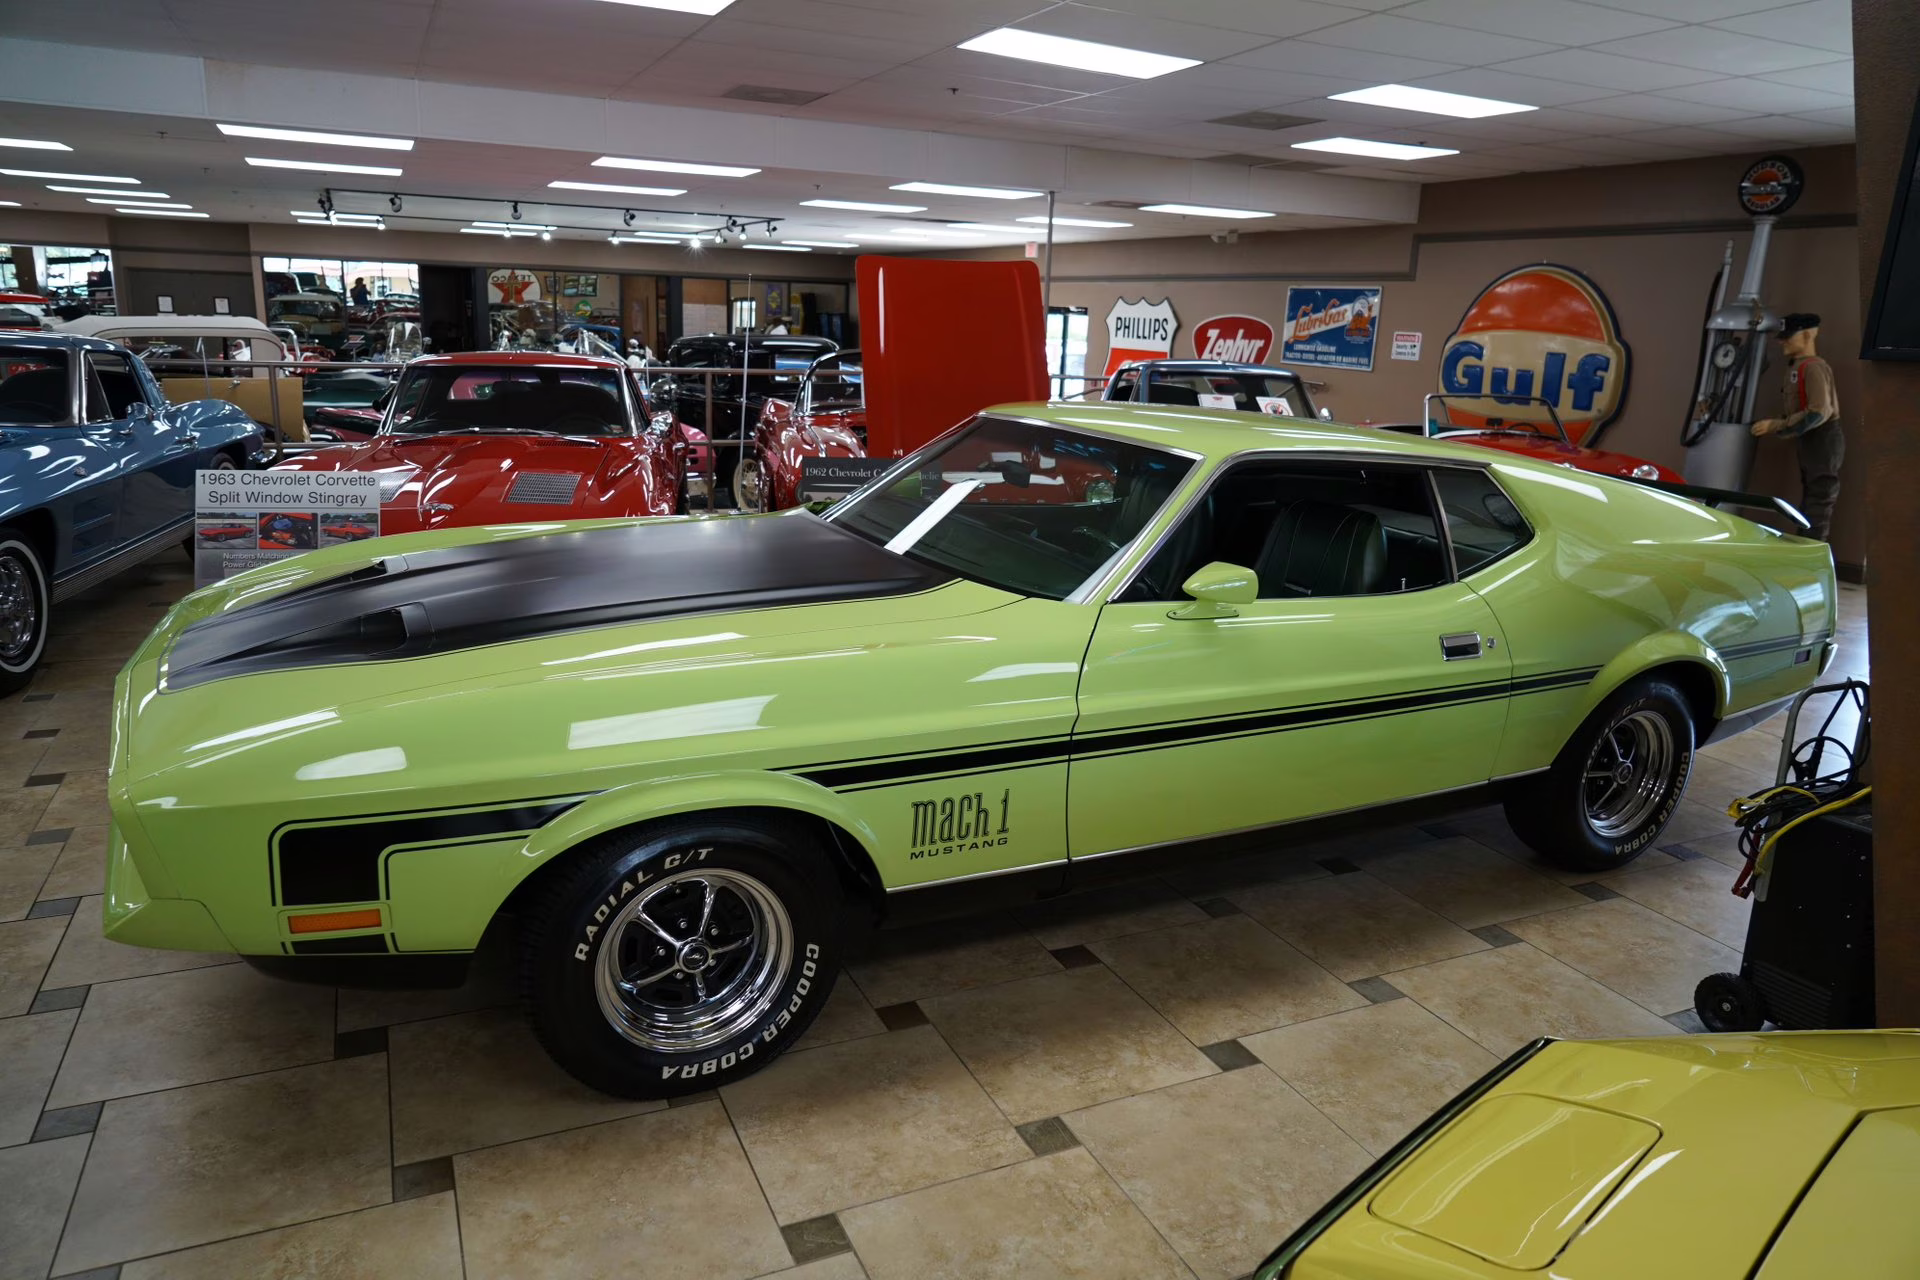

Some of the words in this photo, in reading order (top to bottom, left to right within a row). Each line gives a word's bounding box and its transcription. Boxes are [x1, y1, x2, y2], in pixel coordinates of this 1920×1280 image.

[1115, 316, 1169, 341] PHILLIPS
[1201, 328, 1265, 365] Zephyr
[1442, 340, 1611, 411] Gulf
[200, 473, 236, 485] 1963
[241, 473, 310, 486] Chevrolet
[316, 474, 376, 487] Corvette
[805, 467, 827, 477] 1962
[829, 467, 871, 478] Chevrolet
[208, 490, 241, 505] Split
[245, 491, 303, 504] Window
[308, 491, 367, 507] Stingray
[223, 552, 256, 560] Numbers
[1658, 752, 1690, 823] COOPER
[911, 792, 990, 848] mach
[997, 788, 1010, 835] 1
[910, 837, 1008, 860] MUSTANG
[1615, 825, 1657, 855] COBRA
[574, 870, 654, 961] RADIAL
[664, 848, 714, 870] G/T
[762, 943, 820, 1043] COOPER
[662, 1042, 754, 1080] COBRA
